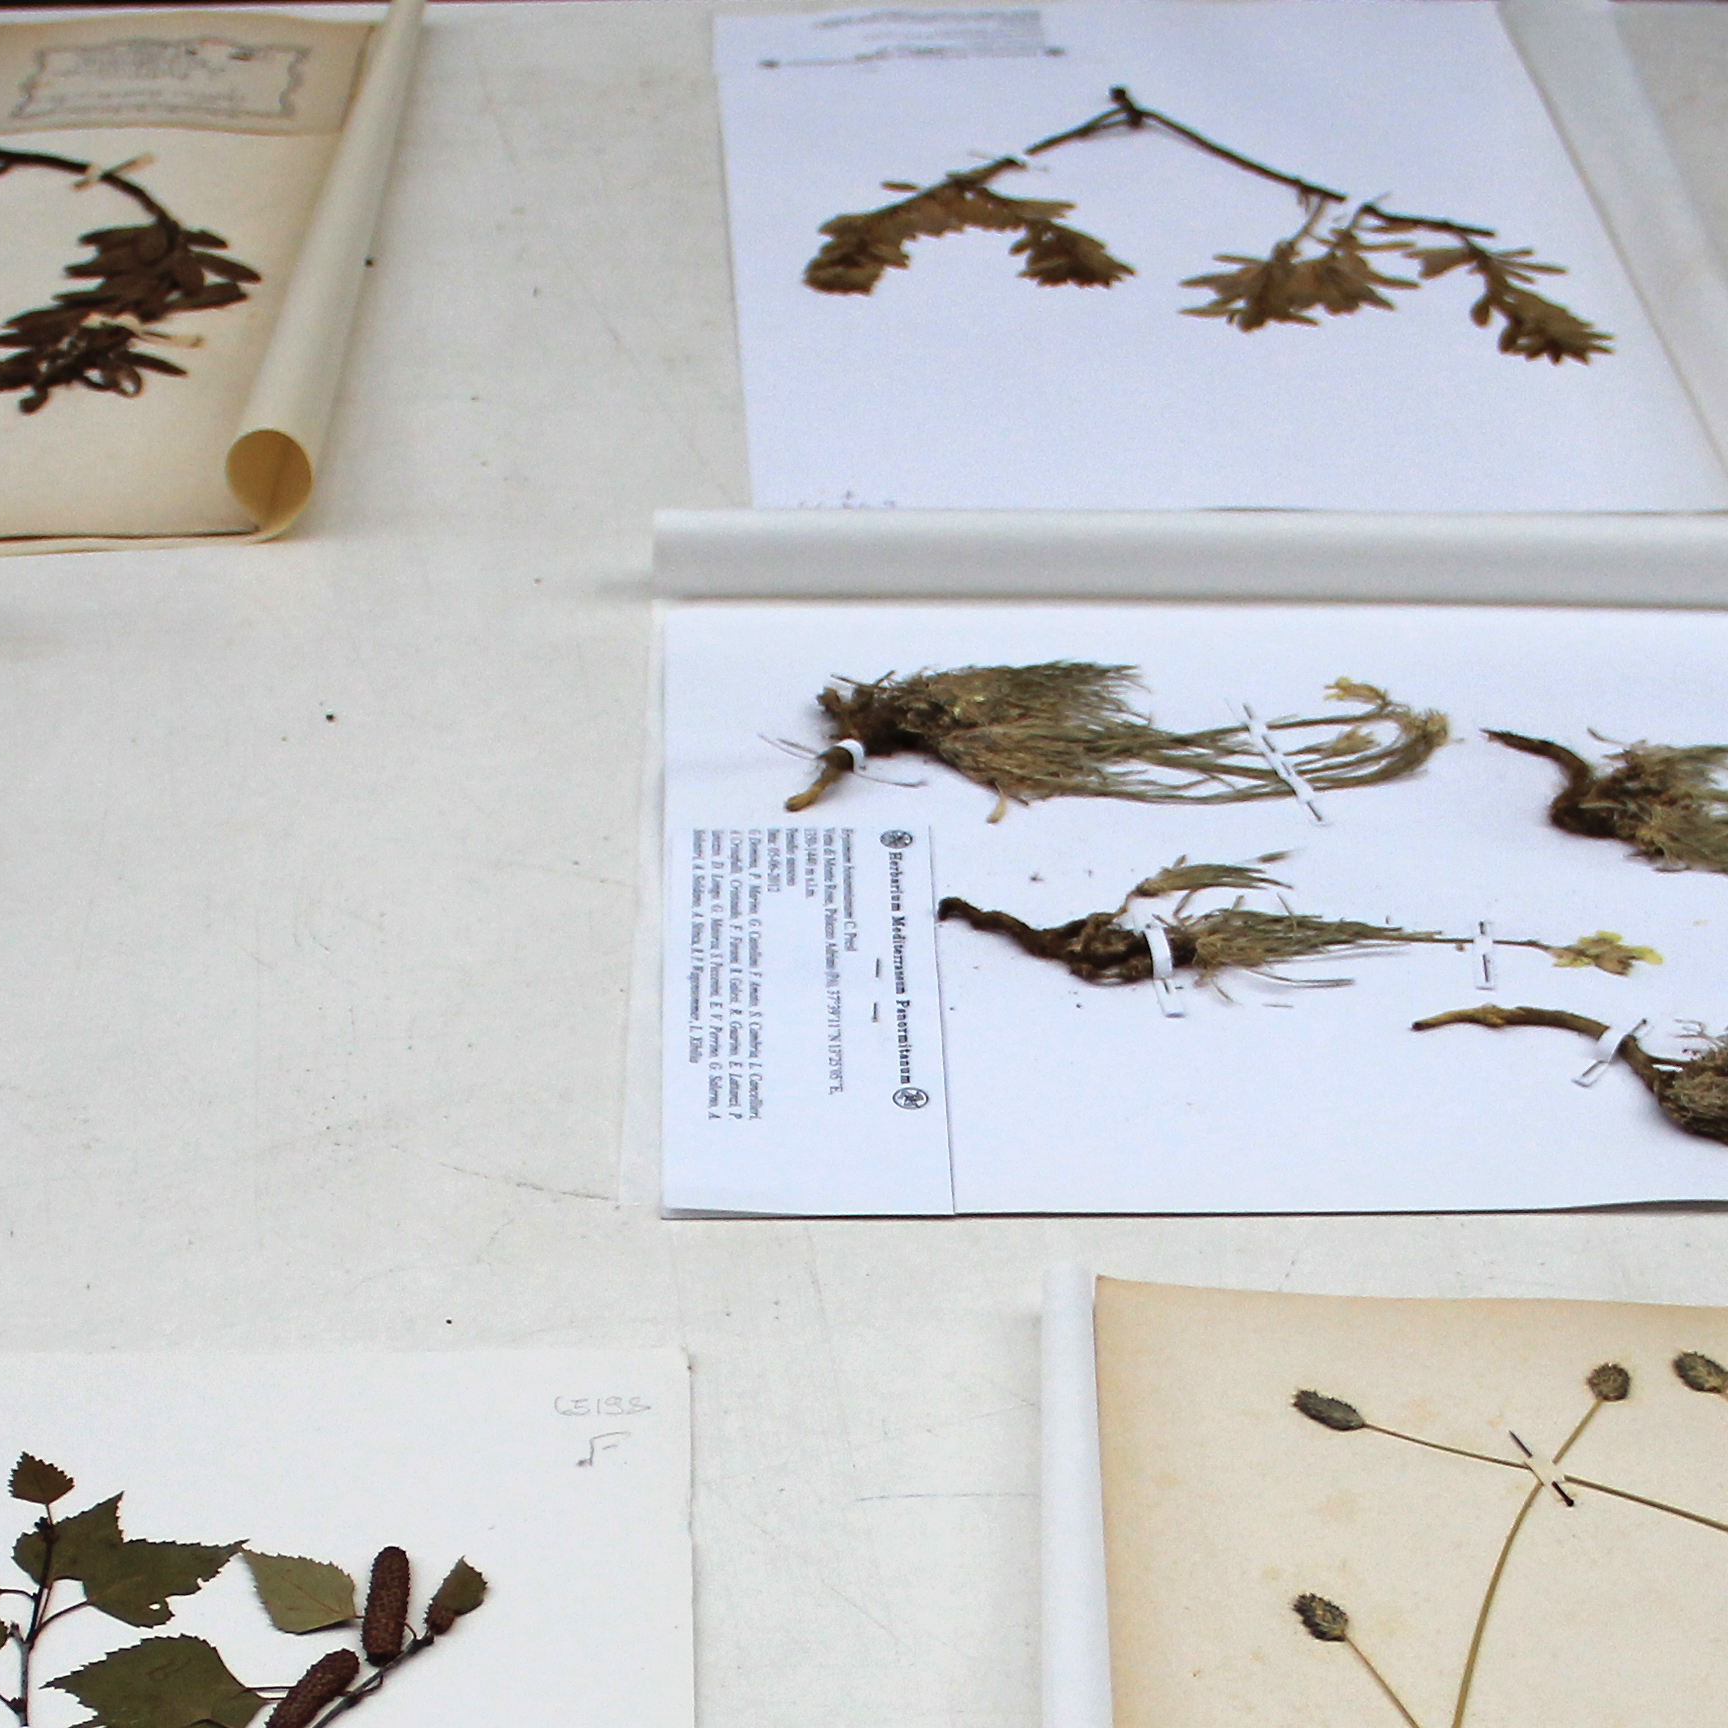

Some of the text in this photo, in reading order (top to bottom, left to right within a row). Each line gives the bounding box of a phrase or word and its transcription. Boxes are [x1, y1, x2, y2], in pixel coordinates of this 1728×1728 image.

[888, 852, 913, 1085] Herbarium Mediterraneum Panormitanum
